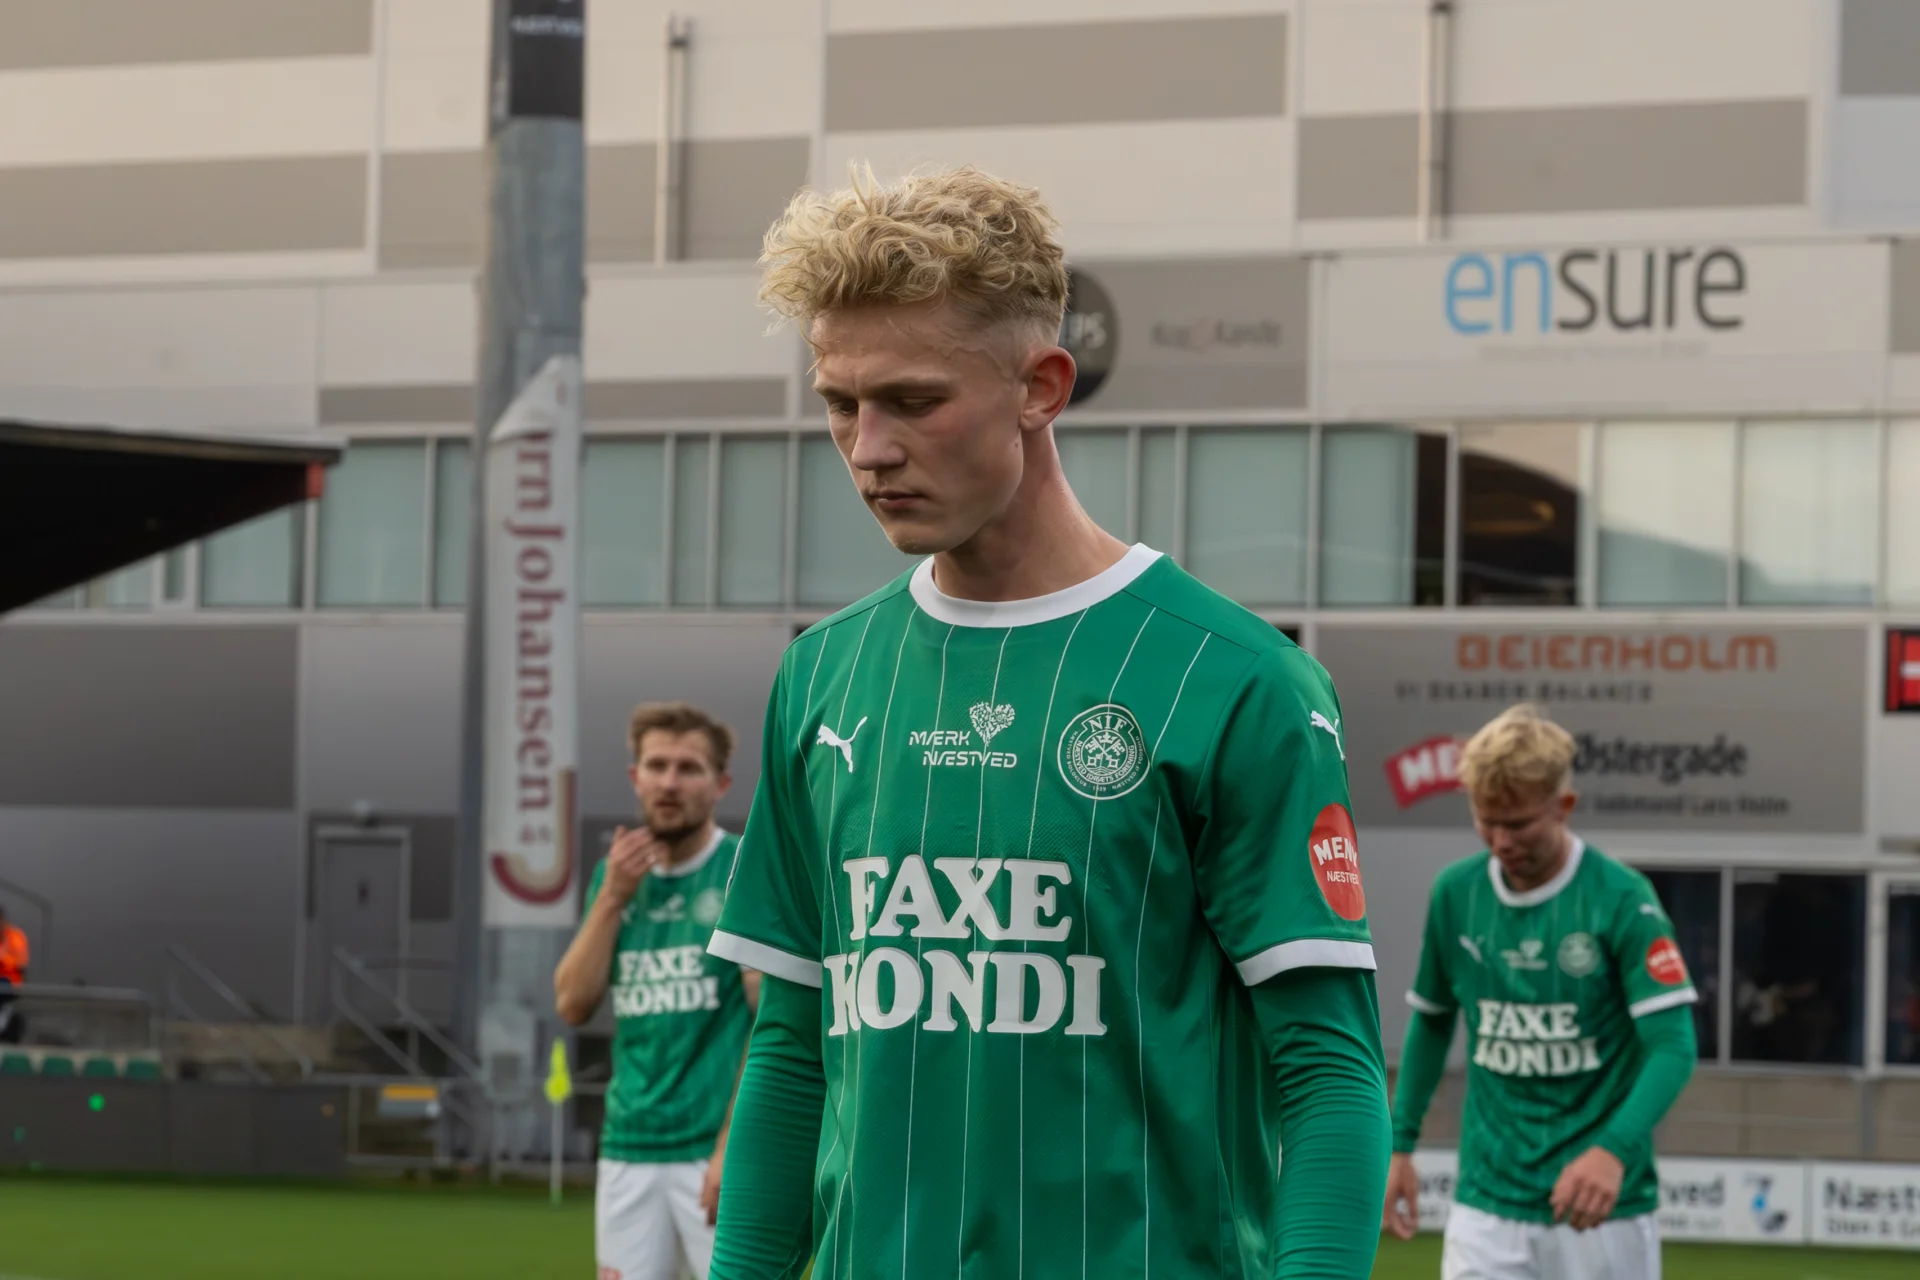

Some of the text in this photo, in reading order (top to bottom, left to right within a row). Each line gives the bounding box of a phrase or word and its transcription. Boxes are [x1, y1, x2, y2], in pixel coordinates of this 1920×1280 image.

[1445, 248, 1746, 335] ensure
[1456, 634, 1777, 672] BEIERHOLM
[909, 730, 971, 746] MÆRK
[1089, 715, 1127, 733] NIF
[922, 750, 1017, 768] NÆSTVED
[1312, 836, 1358, 868] MENY
[842, 854, 1073, 942] FAXE
[618, 944, 705, 985] FAXE
[823, 946, 1109, 1037] KONDI
[1476, 999, 1581, 1041] FAXE
